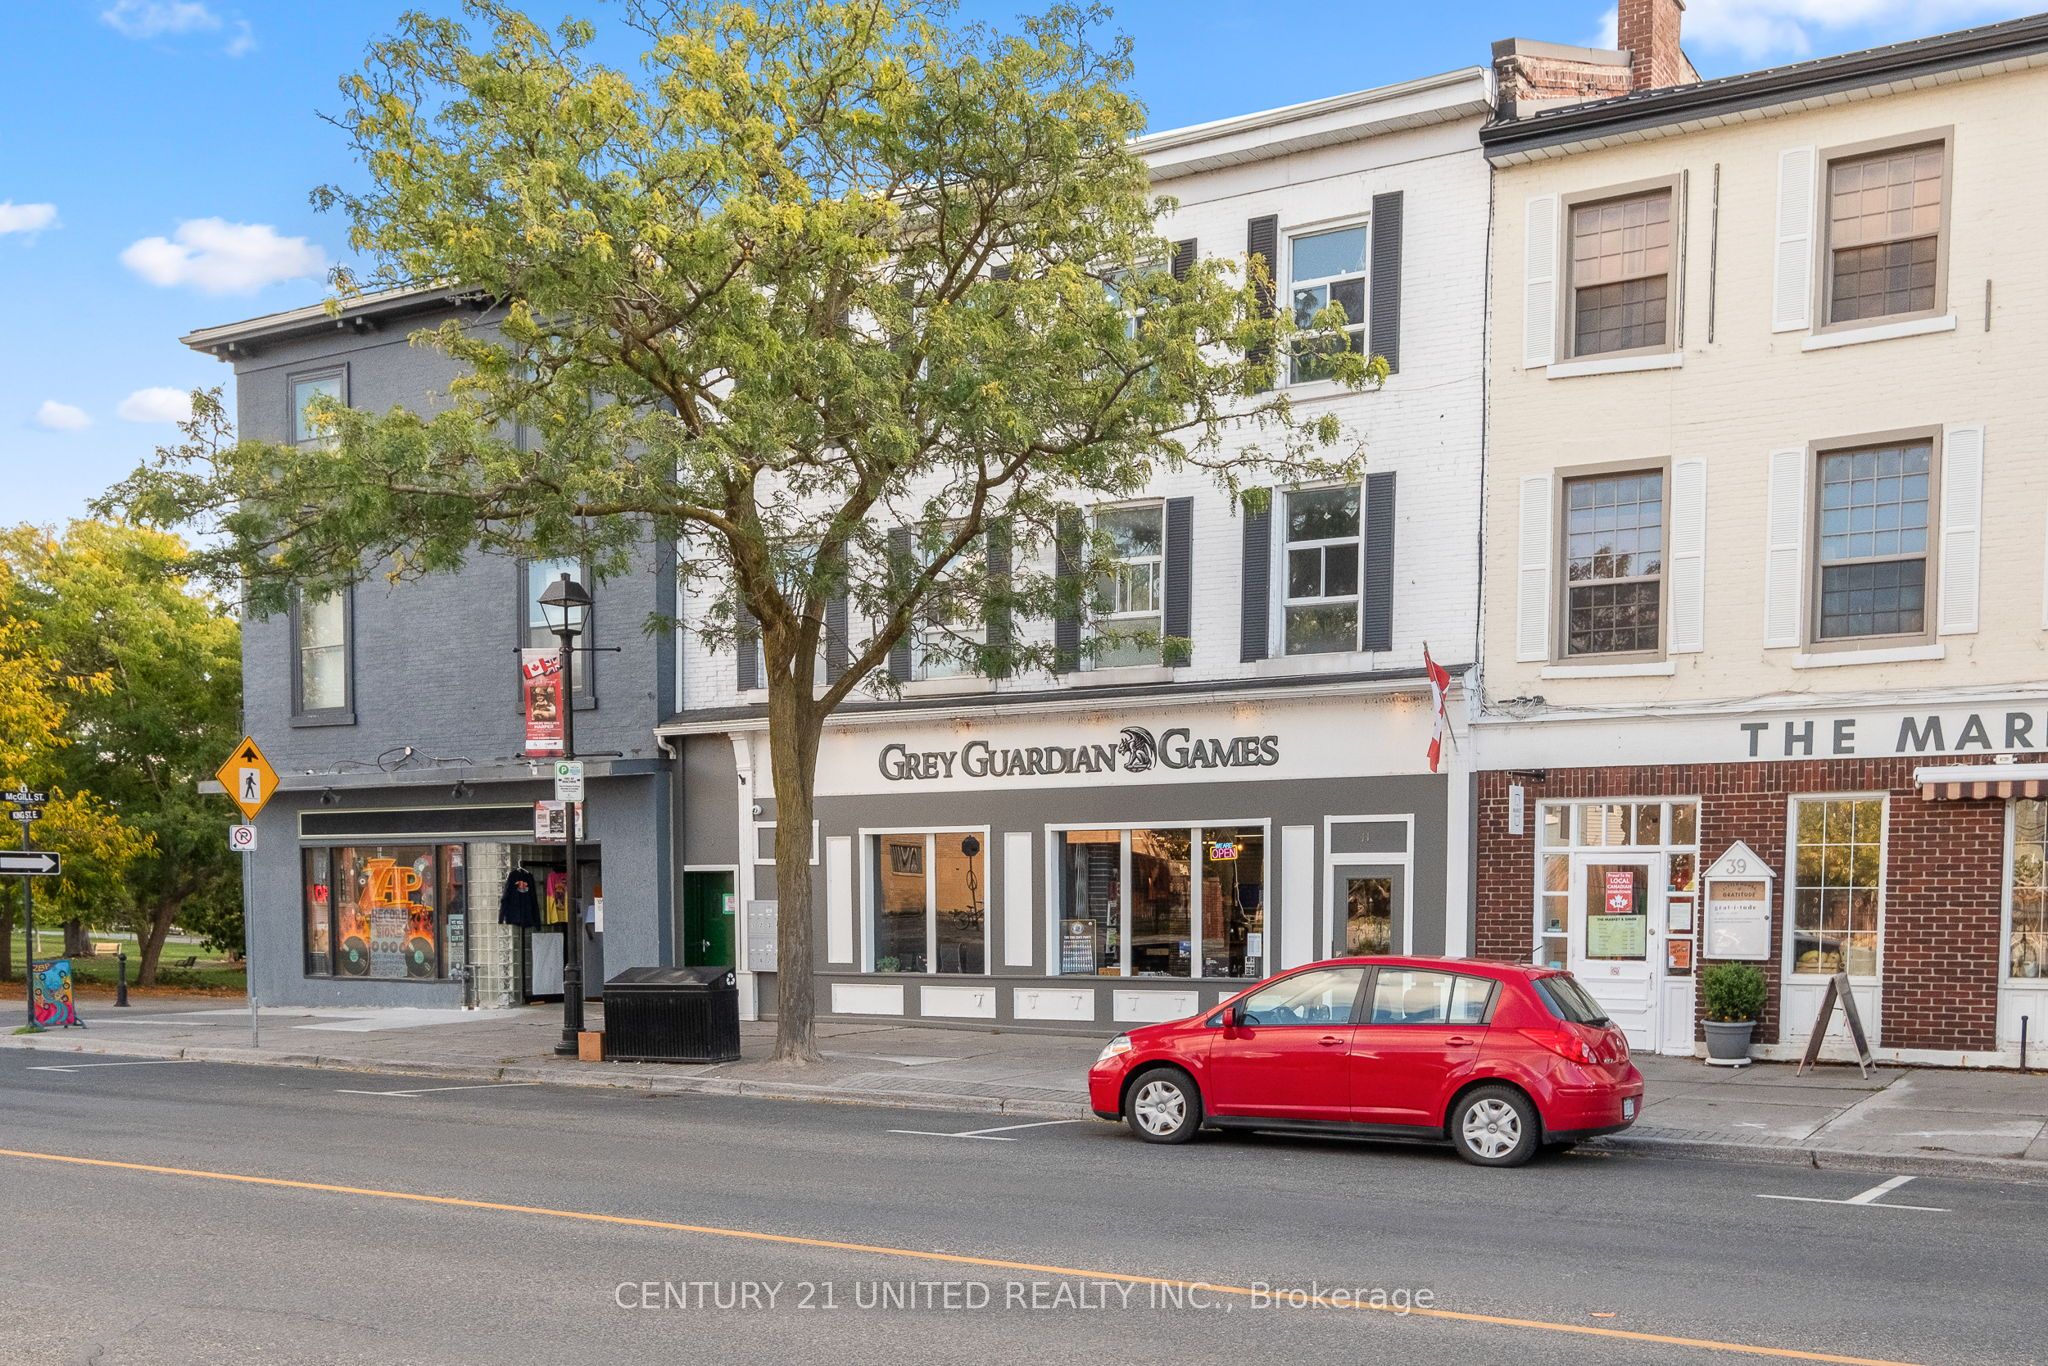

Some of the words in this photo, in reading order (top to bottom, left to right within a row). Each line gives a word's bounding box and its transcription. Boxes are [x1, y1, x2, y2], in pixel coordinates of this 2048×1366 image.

[1740, 719, 1855, 757] THE
[1895, 711, 2048, 752] MAR
[878, 743, 957, 781] GREY
[961, 740, 1118, 777] GUARDIAN
[1158, 728, 1280, 769] GAMES
[5, 792, 33, 801] McGILL
[33, 793, 45, 801] ST.
[1212, 848, 1236, 858] OPEN
[1726, 858, 1747, 874] 39
